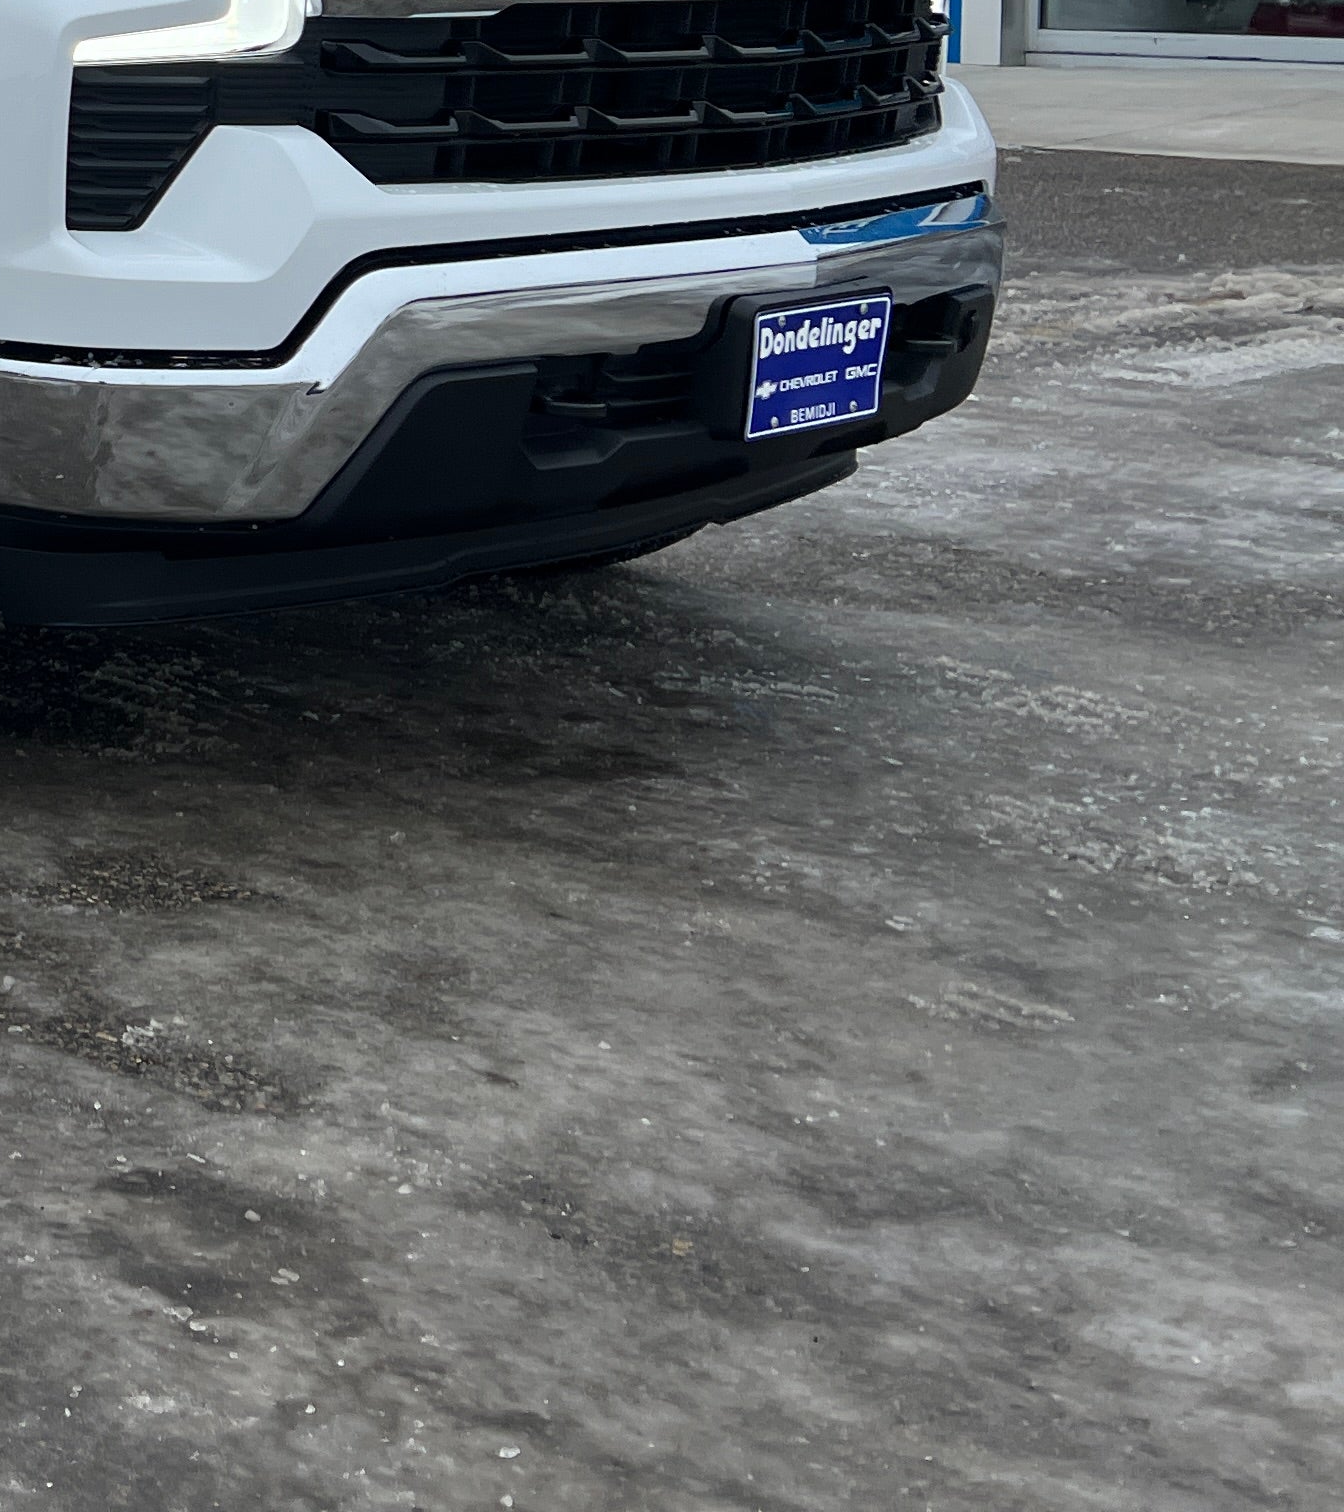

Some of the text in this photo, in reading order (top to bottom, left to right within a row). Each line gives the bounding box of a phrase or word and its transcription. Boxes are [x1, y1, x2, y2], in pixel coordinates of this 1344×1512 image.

[760, 317, 882, 359] Dondelinger
[779, 363, 878, 392] CHEVROLET GMC
[790, 402, 836, 424] BEMIDJI
